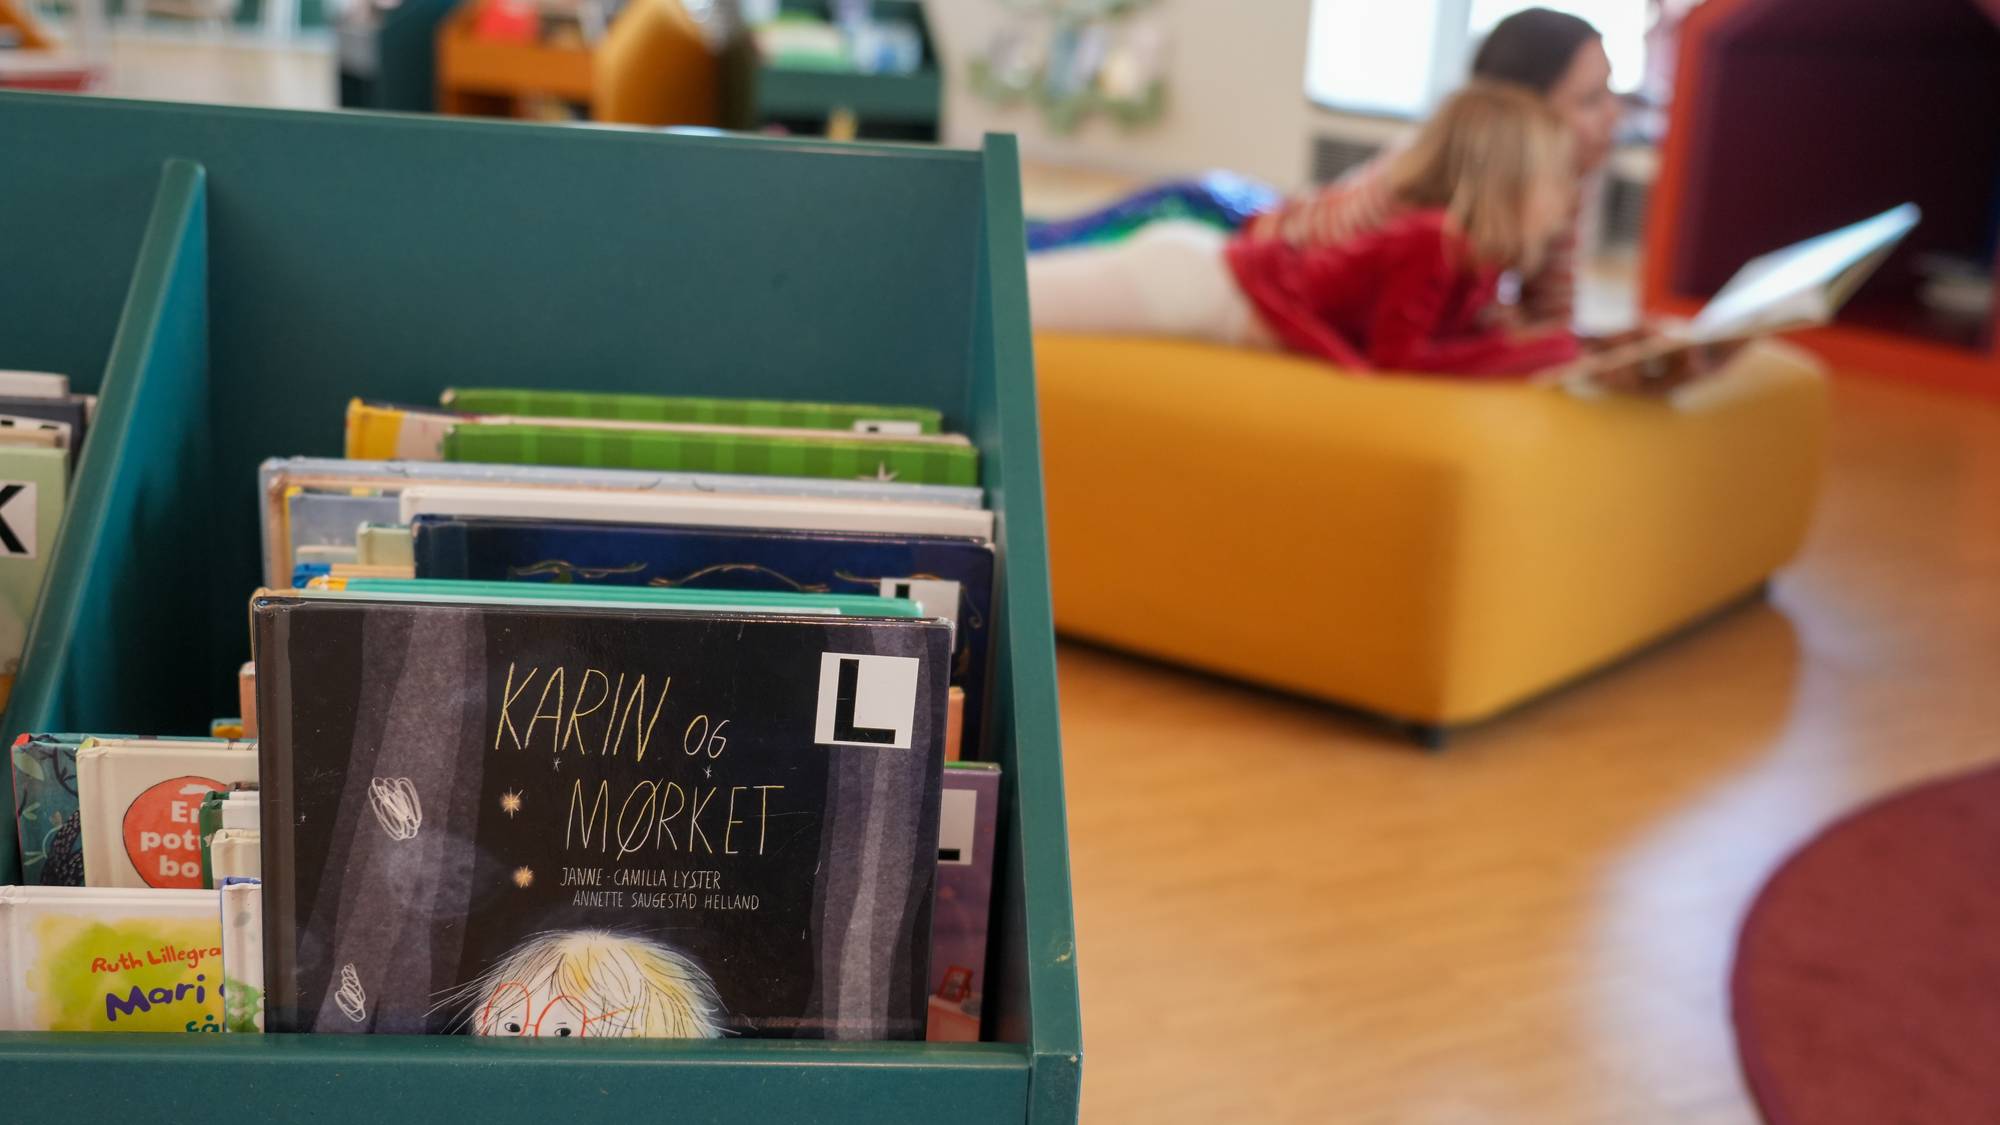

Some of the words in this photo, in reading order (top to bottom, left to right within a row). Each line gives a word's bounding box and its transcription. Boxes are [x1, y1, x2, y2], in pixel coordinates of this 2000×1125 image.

[495, 661, 671, 762] KARIN
[684, 714, 730, 759] OG
[832, 657, 896, 745] L
[565, 777, 785, 861] MØRKET
[572, 890, 624, 908] ANNETTE
[631, 891, 697, 910] SAUGESTAD
[704, 894, 760, 911] HELLAND
[673, 870, 721, 889] LYSTER
[91, 952, 143, 973] Ruth
[105, 974, 206, 1022] Mari
